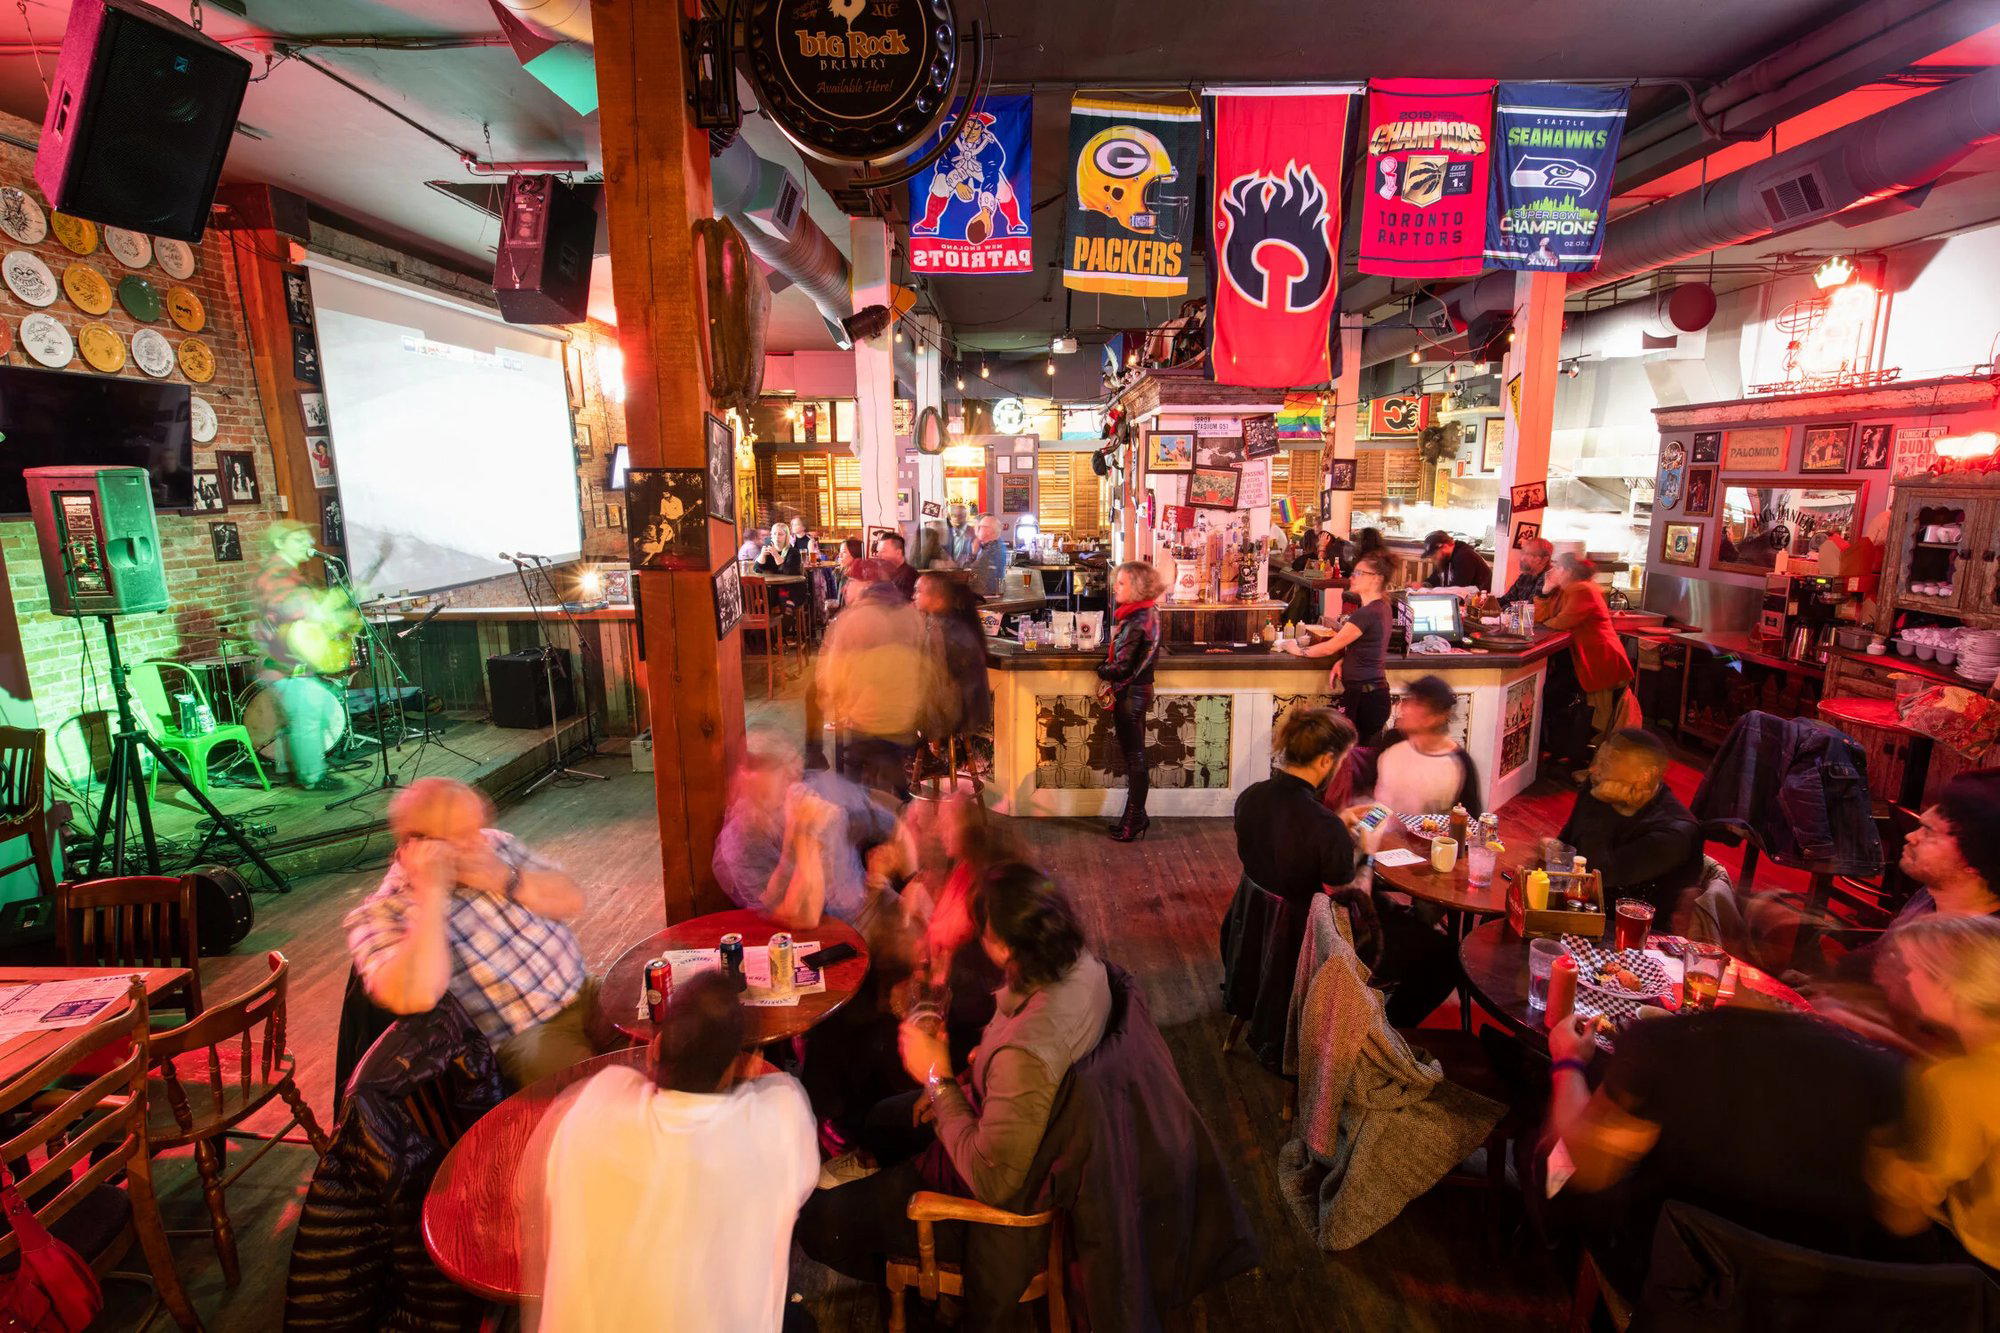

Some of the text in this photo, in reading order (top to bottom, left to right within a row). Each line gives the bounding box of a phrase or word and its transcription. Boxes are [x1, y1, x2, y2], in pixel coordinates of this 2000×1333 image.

[846, 30, 910, 59] Rock
[820, 58, 886, 71] BREWERY
[816, 79, 893, 94] Available Here!
[1399, 112, 1432, 121] 2019
[1537, 118, 1584, 126] SEATTLE
[1369, 121, 1487, 156] CHAMPIONS
[1508, 127, 1608, 149] SEAHAWKS
[1379, 211, 1463, 227] TORONTO
[1514, 209, 1581, 221] SUPER BOWL
[1500, 217, 1597, 235] CHAMPIONS
[1378, 230, 1462, 246] RAPTORS
[1073, 236, 1183, 277] PACKERS
[1730, 447, 1779, 458] PALOMINO
[1752, 508, 1776, 528] JACK
